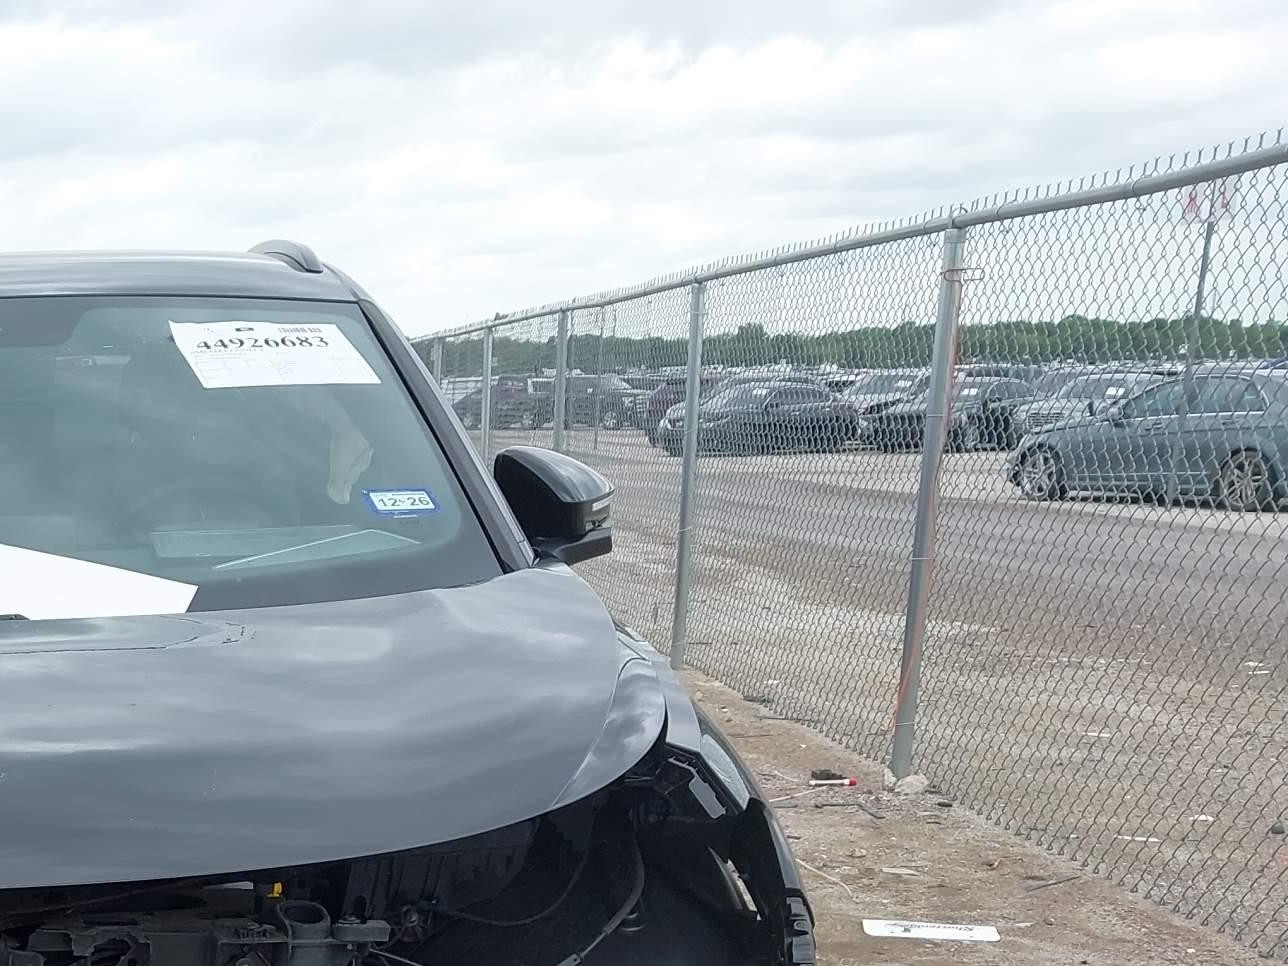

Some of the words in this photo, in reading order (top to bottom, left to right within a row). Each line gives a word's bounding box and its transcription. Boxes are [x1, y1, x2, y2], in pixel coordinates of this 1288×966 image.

[196, 335, 329, 350] 44926683
[378, 497, 398, 507] 12
[407, 496, 430, 506] 26
